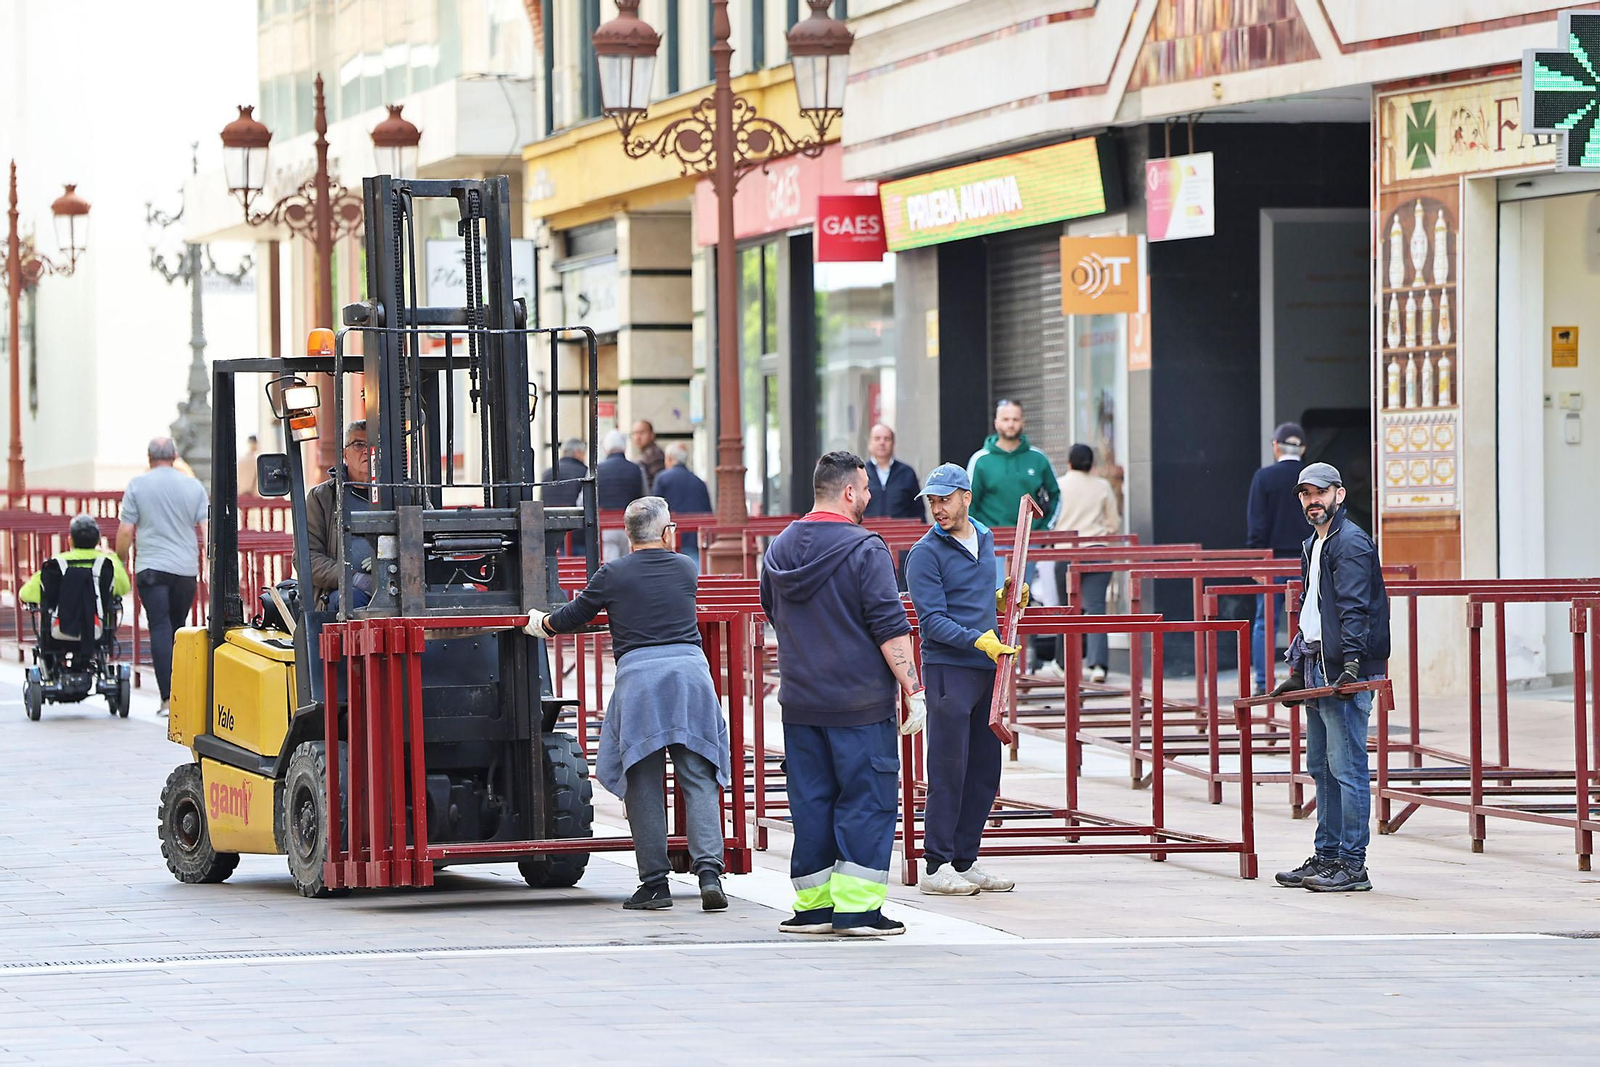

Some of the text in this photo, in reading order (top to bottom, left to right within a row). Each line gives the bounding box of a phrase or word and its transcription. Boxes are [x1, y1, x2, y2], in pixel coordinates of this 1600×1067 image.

[906, 187, 962, 231] PRUEBA
[960, 175, 1023, 221] AUDITIVA
[822, 215, 880, 235] GAES
[217, 704, 234, 731] Yale
